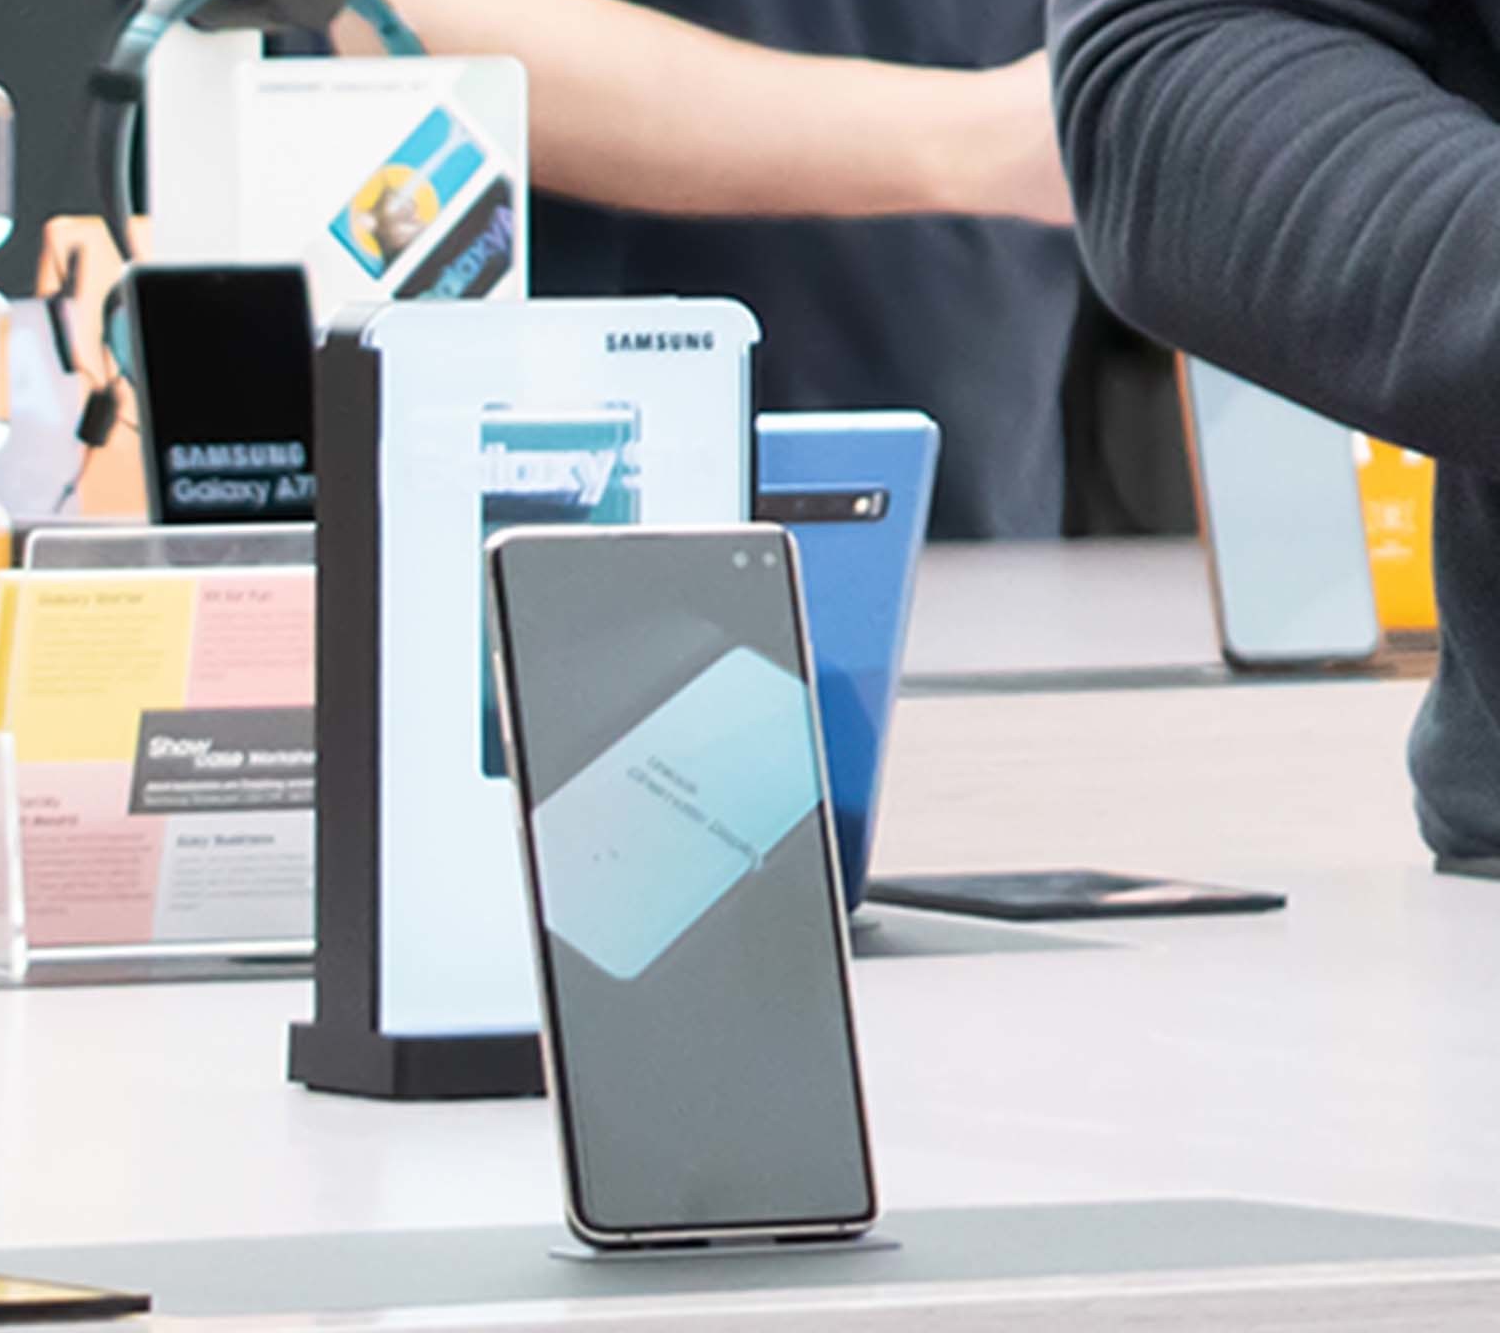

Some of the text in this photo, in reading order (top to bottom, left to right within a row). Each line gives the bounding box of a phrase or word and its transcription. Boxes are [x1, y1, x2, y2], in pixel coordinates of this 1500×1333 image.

[605, 331, 715, 352] SAMSUNG
[169, 442, 306, 470] SAMSUNG
[173, 477, 271, 508] Galaxy
